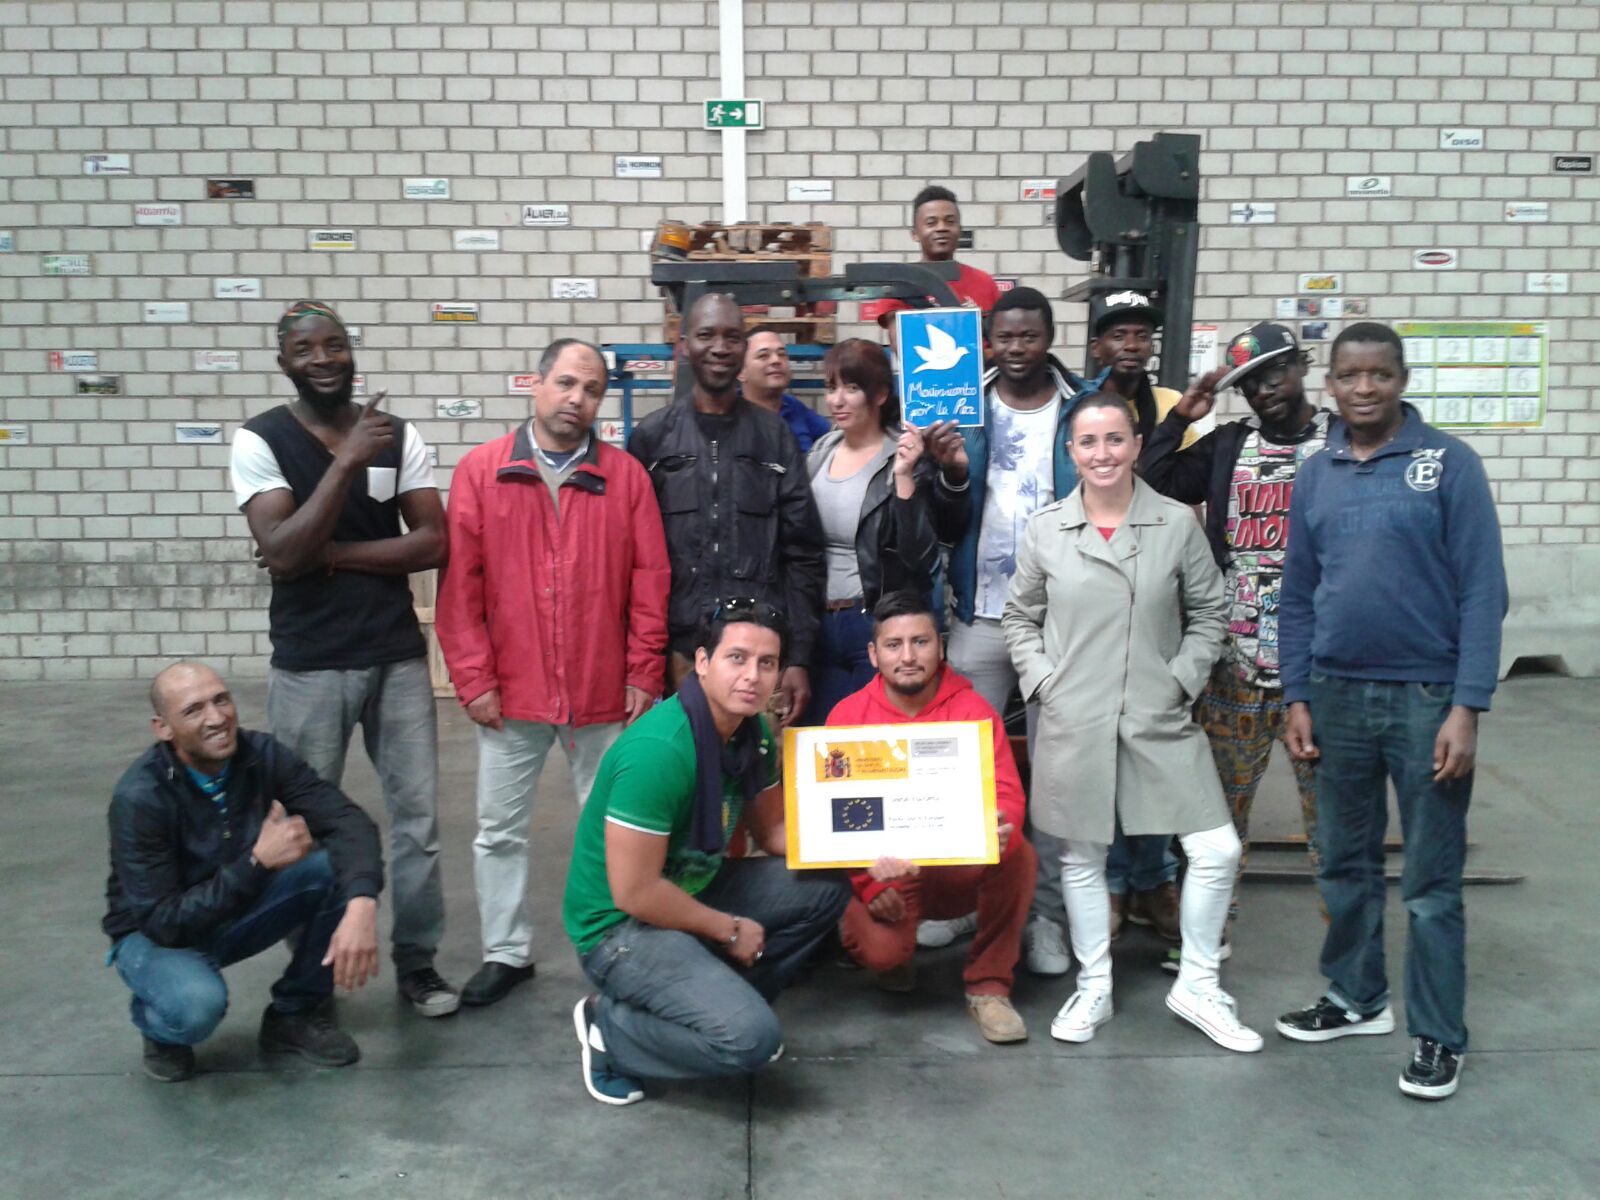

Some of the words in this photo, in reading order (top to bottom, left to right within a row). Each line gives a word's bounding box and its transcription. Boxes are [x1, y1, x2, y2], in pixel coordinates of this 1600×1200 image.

[1445, 340, 1460, 360] 2
[1446, 401, 1460, 421] 8
[1513, 400, 1535, 421] 10
[1413, 462, 1436, 485] E
